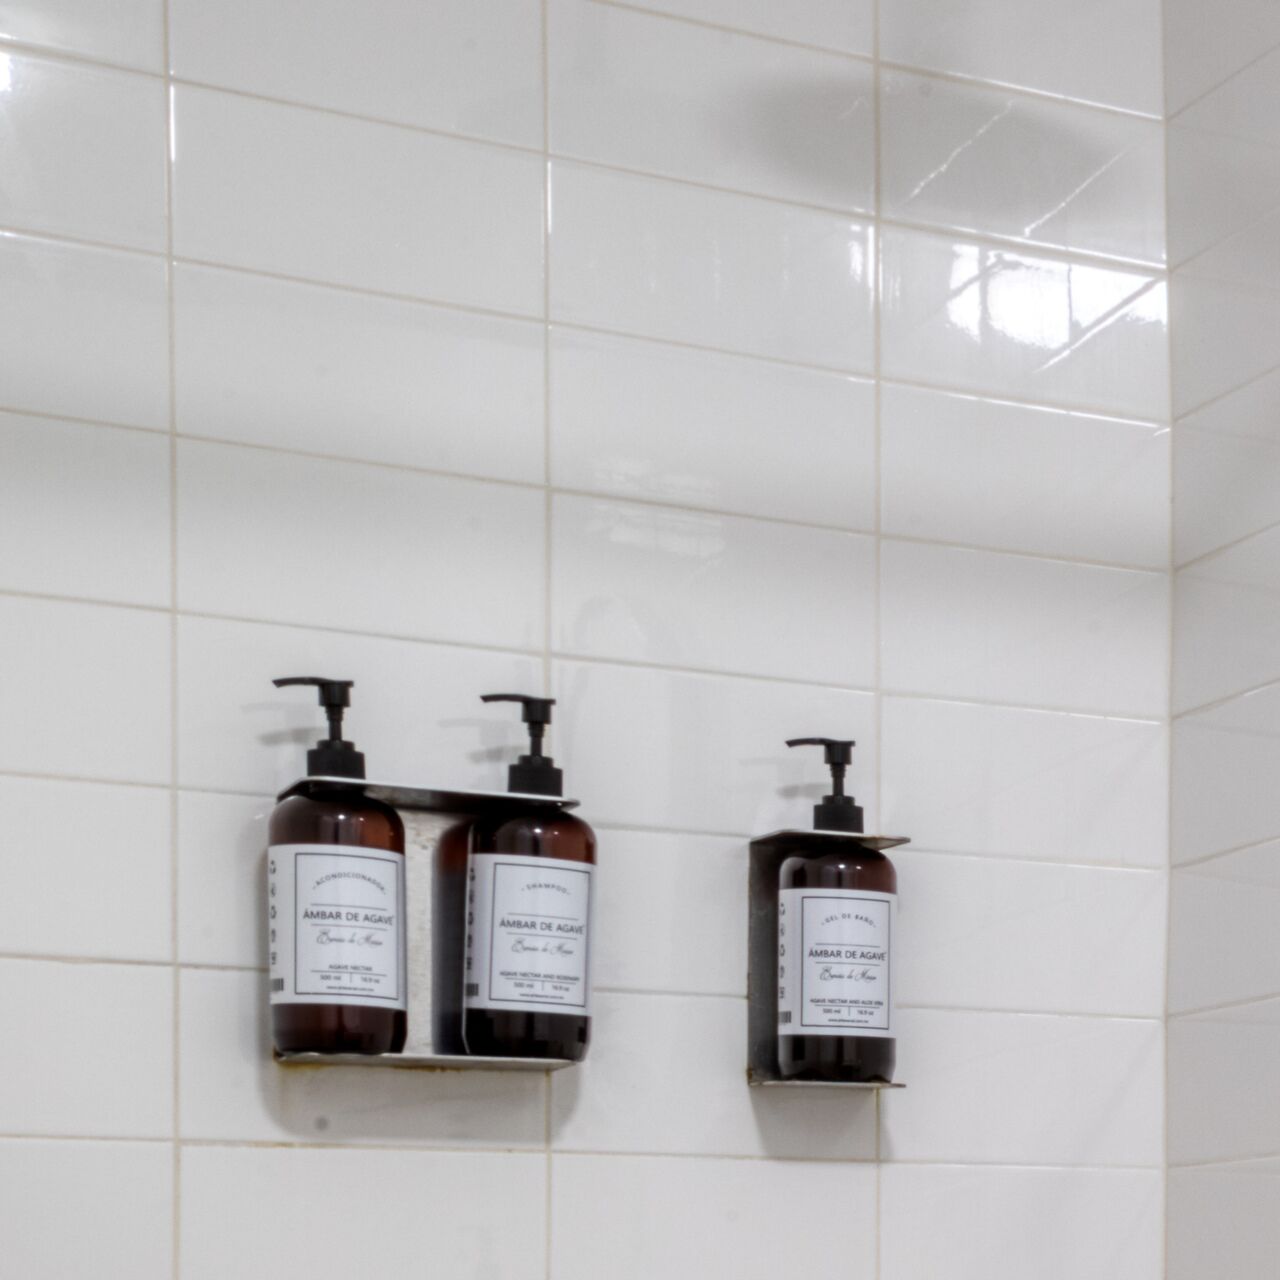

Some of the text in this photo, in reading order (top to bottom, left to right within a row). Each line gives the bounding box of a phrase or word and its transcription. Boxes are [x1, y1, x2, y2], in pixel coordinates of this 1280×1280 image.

[345, 911, 360, 922] DE
[540, 922, 553, 931] DE
[845, 950, 858, 959] DE
